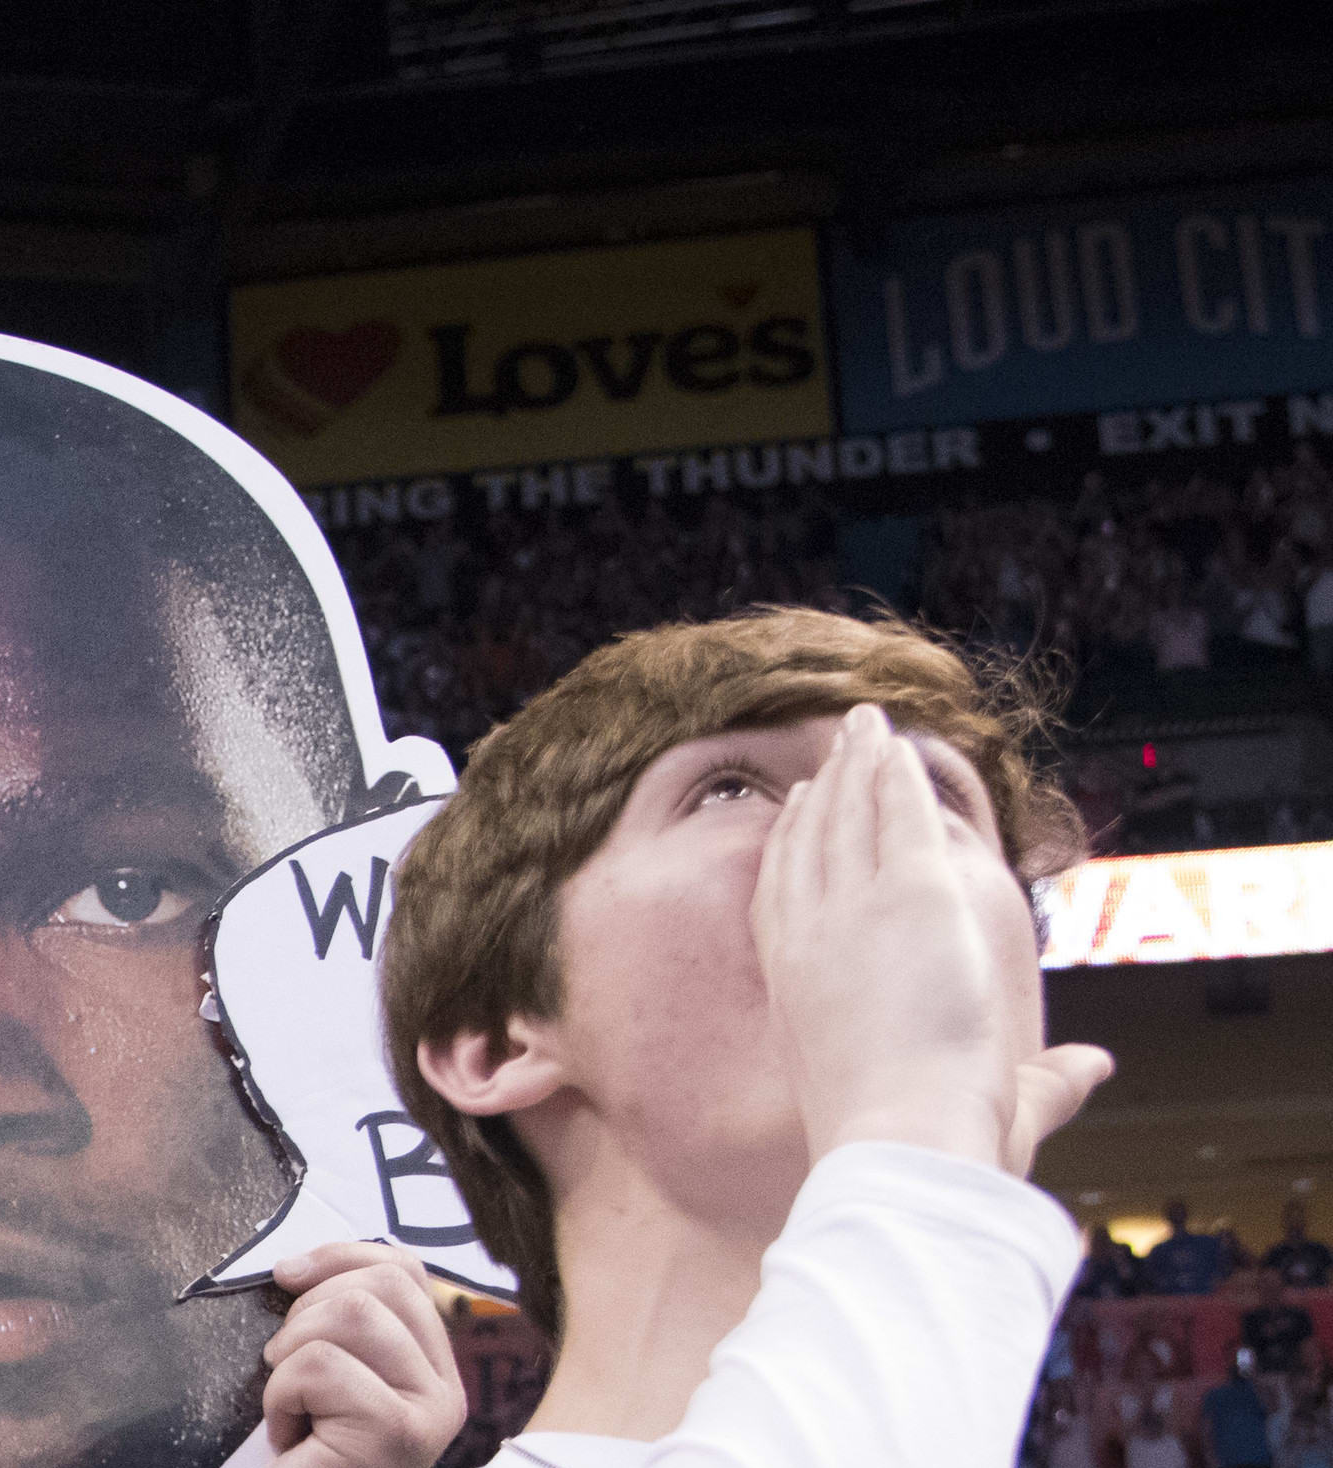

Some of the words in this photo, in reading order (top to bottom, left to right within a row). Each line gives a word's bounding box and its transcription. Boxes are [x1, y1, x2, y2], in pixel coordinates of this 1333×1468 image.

[884, 217, 1139, 396] LOUD
[311, 479, 454, 527] ING
[474, 463, 614, 512] THE
[638, 426, 980, 500] THUNDER
[1097, 400, 1269, 456] EXIT
